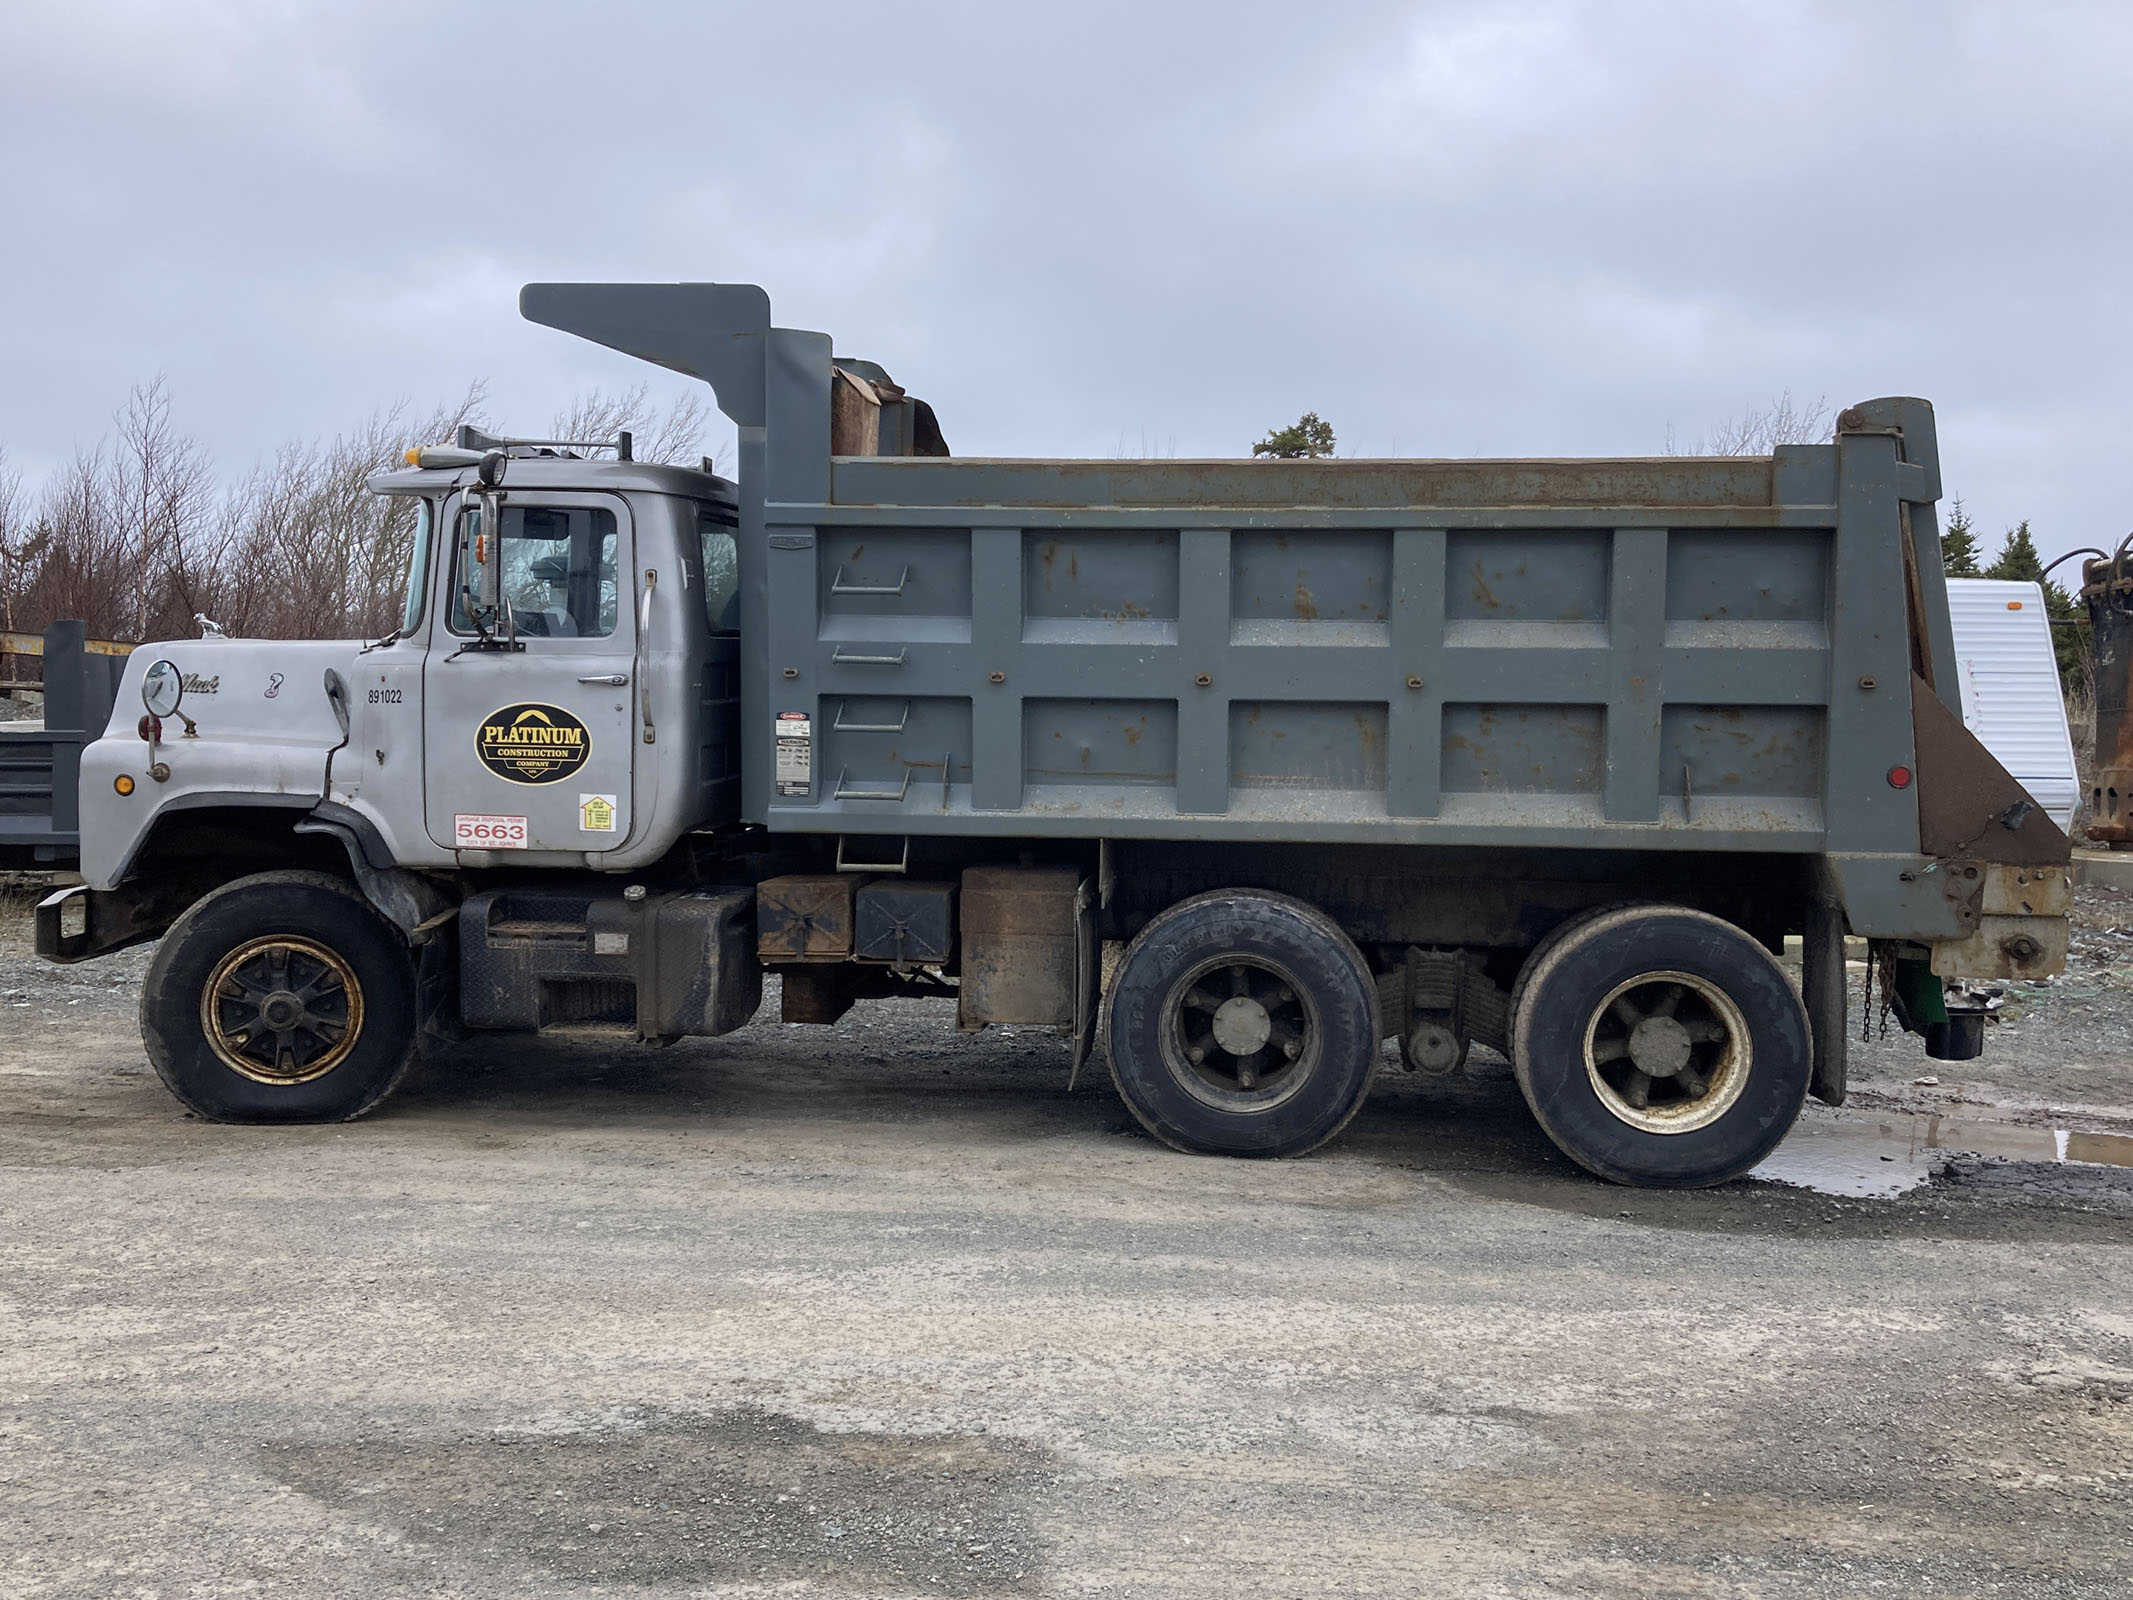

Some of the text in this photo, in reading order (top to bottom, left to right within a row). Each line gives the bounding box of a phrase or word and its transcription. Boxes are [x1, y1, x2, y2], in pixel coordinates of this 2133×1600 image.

[368, 689, 402, 704] 891022
[484, 726, 582, 745] PLATINUM
[497, 748, 569, 758] CONSTRUCTION
[457, 824, 525, 840] 5663
